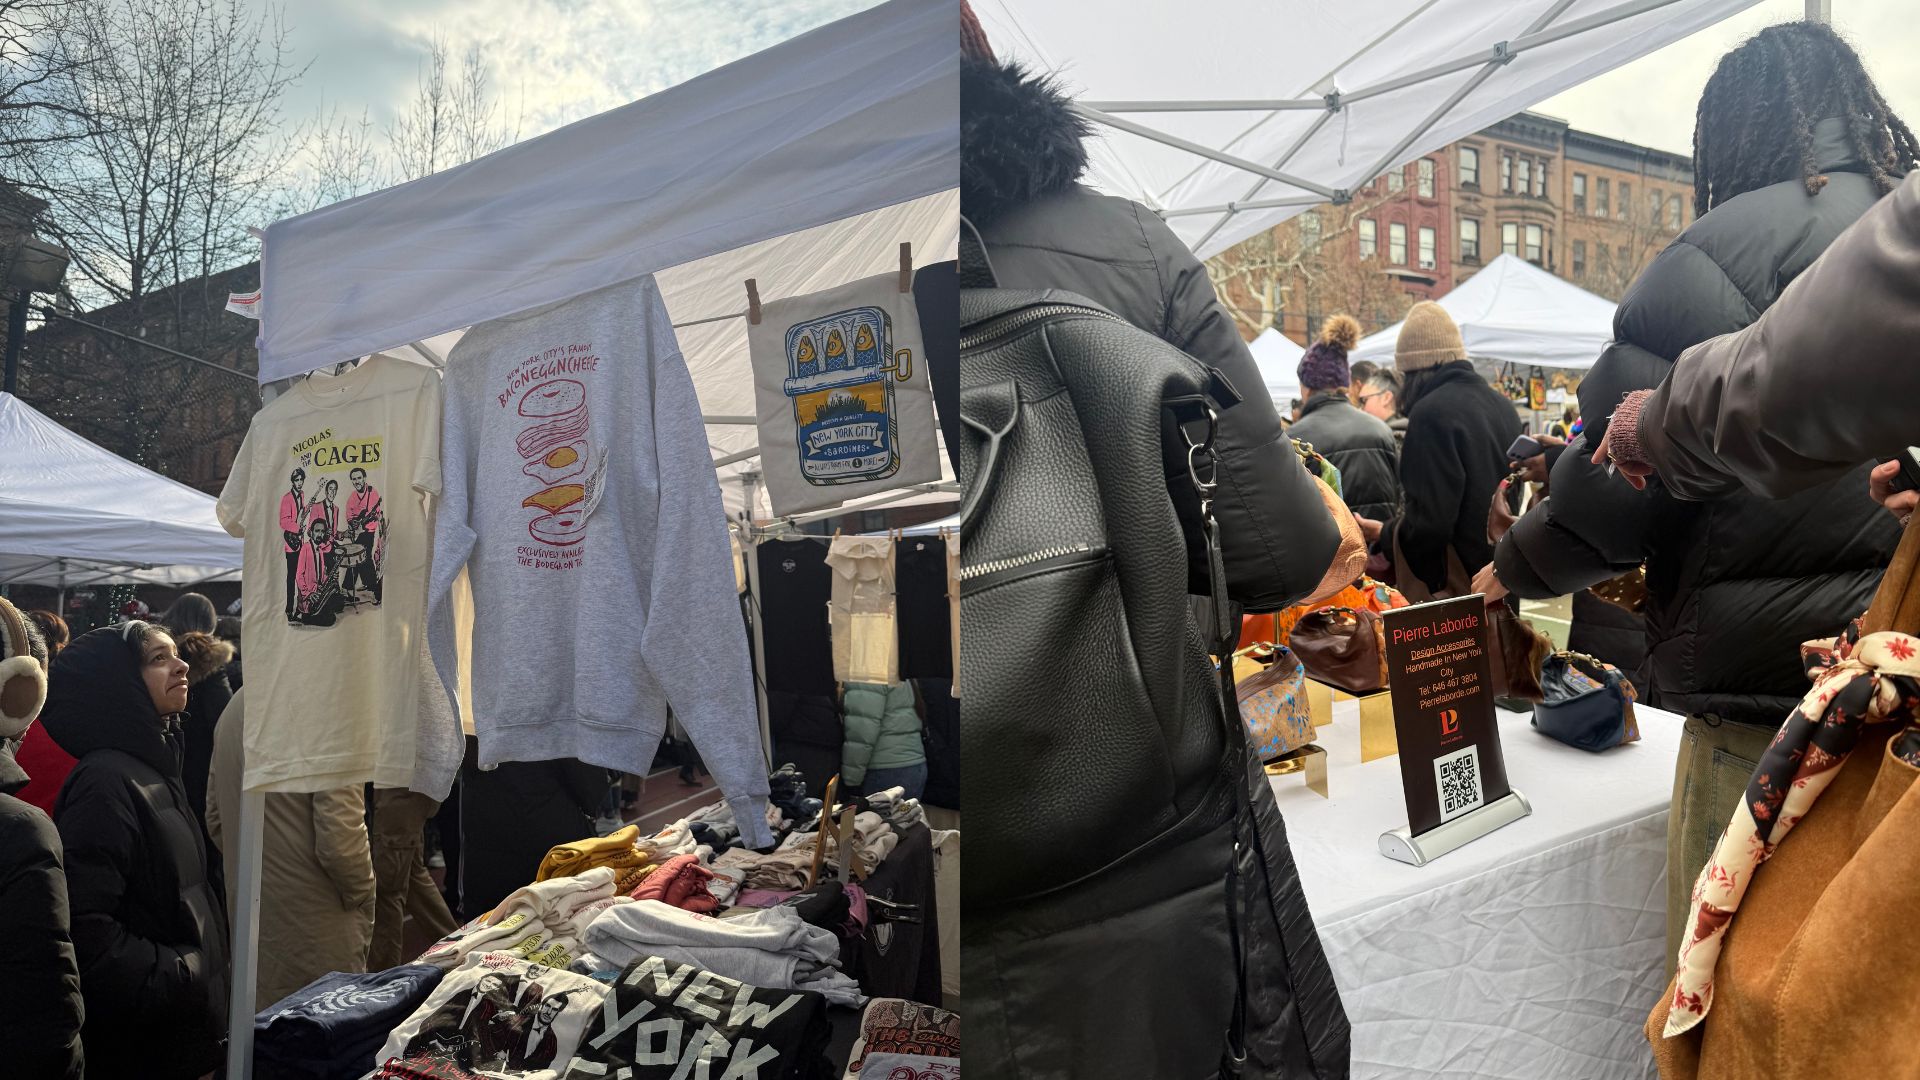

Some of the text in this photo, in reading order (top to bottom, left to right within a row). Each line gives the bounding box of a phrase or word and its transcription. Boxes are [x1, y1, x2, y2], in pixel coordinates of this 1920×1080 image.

[521, 354, 540, 369] YORK
[292, 428, 332, 455] NICOLAS
[834, 426, 854, 439] YORK
[300, 452, 312, 462] AND
[314, 442, 381, 467] CAGES
[517, 546, 559, 559] EXCLUSIVELY
[517, 556, 532, 566] THE
[535, 559, 563, 570] BODEGA
[564, 560, 574, 570] ON
[1393, 613, 1479, 645] Pierre Laborde
[1410, 636, 1476, 660] Design Accessories
[1405, 657, 1443, 674] Handmade
[1452, 651, 1468, 661] New
[1468, 646, 1483, 658] York
[1440, 666, 1454, 678] City
[1418, 683, 1432, 696] Tel:
[1432, 680, 1446, 691] 646
[1447, 676, 1460, 688] 467
[1419, 685, 1481, 709] Pierrelaborde.com
[623, 955, 804, 1029] NEW
[588, 987, 780, 1080] YORK
[868, 1027, 911, 1043] THE
